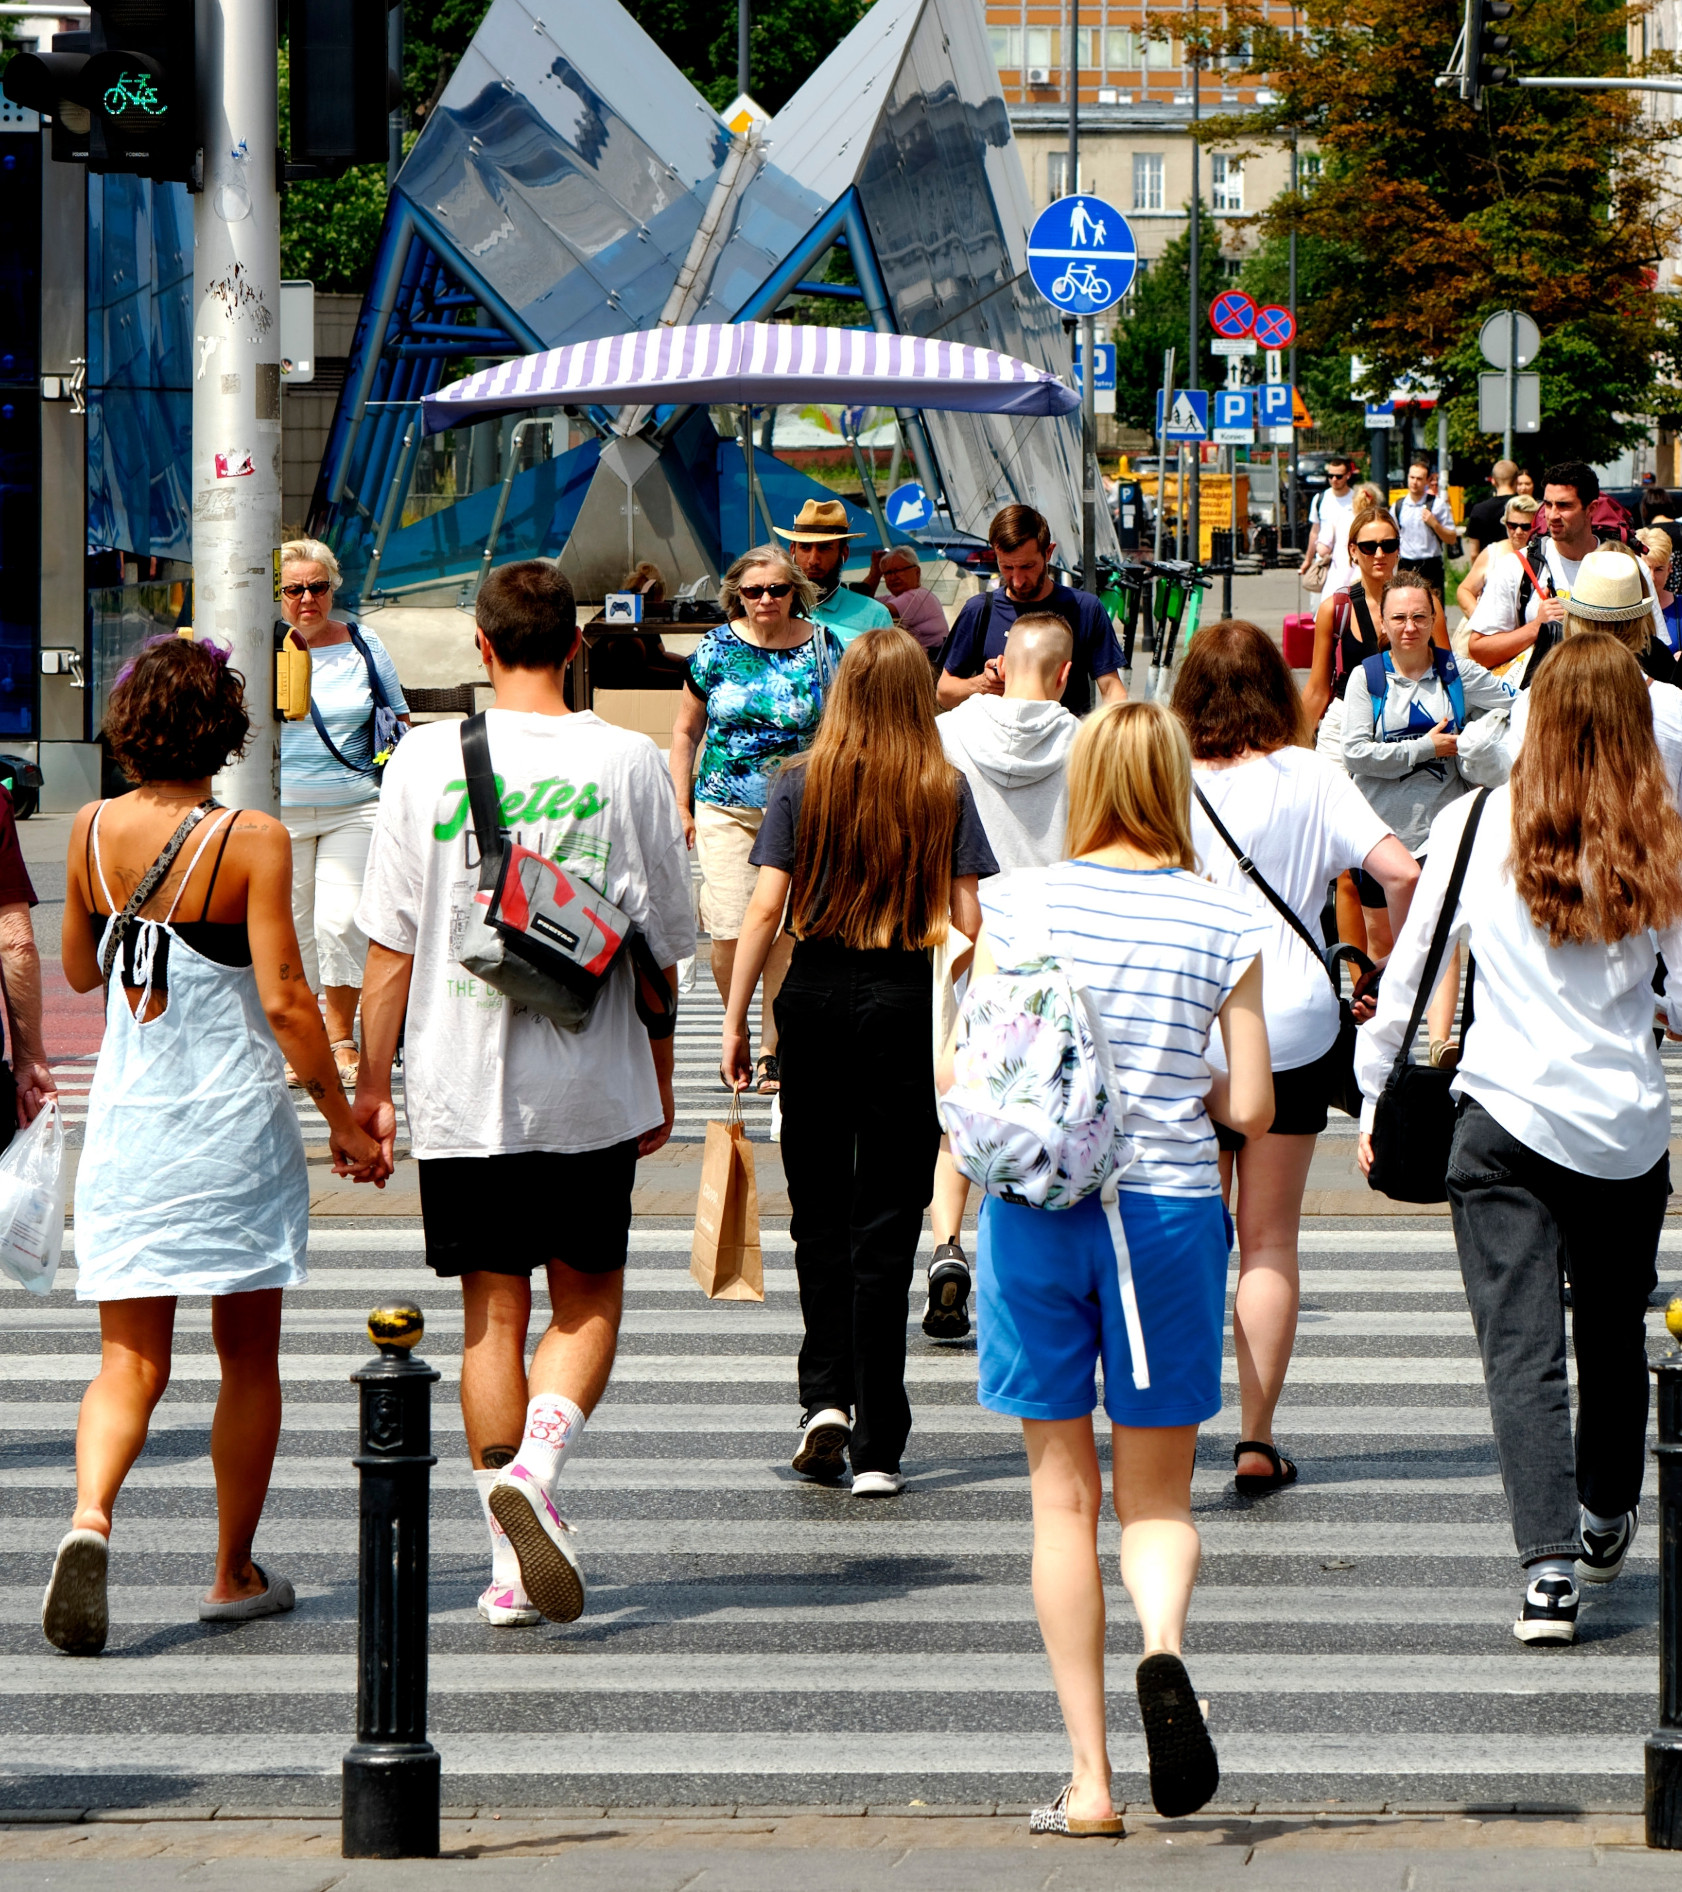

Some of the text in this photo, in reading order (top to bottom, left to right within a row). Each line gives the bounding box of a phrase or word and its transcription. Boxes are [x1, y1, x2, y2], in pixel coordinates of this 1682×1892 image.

[1224, 395, 1246, 425] P
[1265, 386, 1287, 414] P
[1220, 432, 1247, 441] Koniec
[1122, 487, 1132, 500] P
[536, 918, 575, 944] FREITAG
[446, 979, 478, 998] THE
